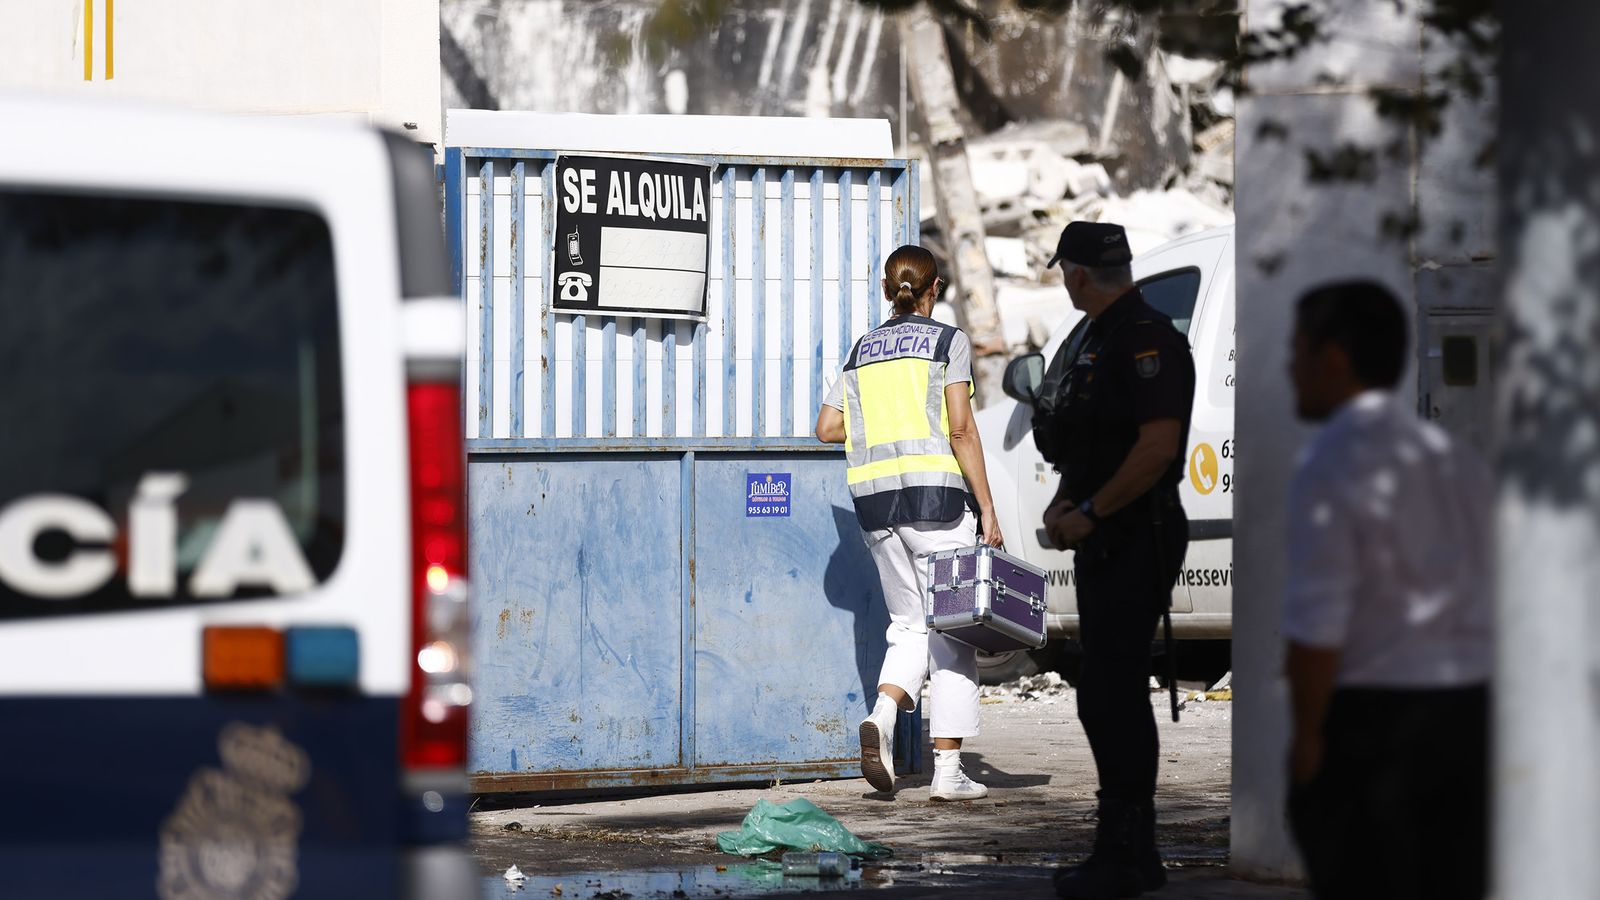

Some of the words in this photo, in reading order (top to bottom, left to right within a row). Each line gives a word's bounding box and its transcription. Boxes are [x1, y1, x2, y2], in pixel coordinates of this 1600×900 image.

[563, 167, 597, 214] SE
[606, 170, 707, 222] ALQUILA
[863, 328, 890, 342] CUERPO
[890, 324, 925, 336] NACIONAL
[926, 327, 939, 336] DE
[859, 336, 930, 362] POLICIA
[748, 506, 761, 514] 955
[762, 506, 770, 514] 63
[772, 506, 779, 514] 19
[780, 506, 788, 514] 01
[0, 471, 316, 598] CÍA
